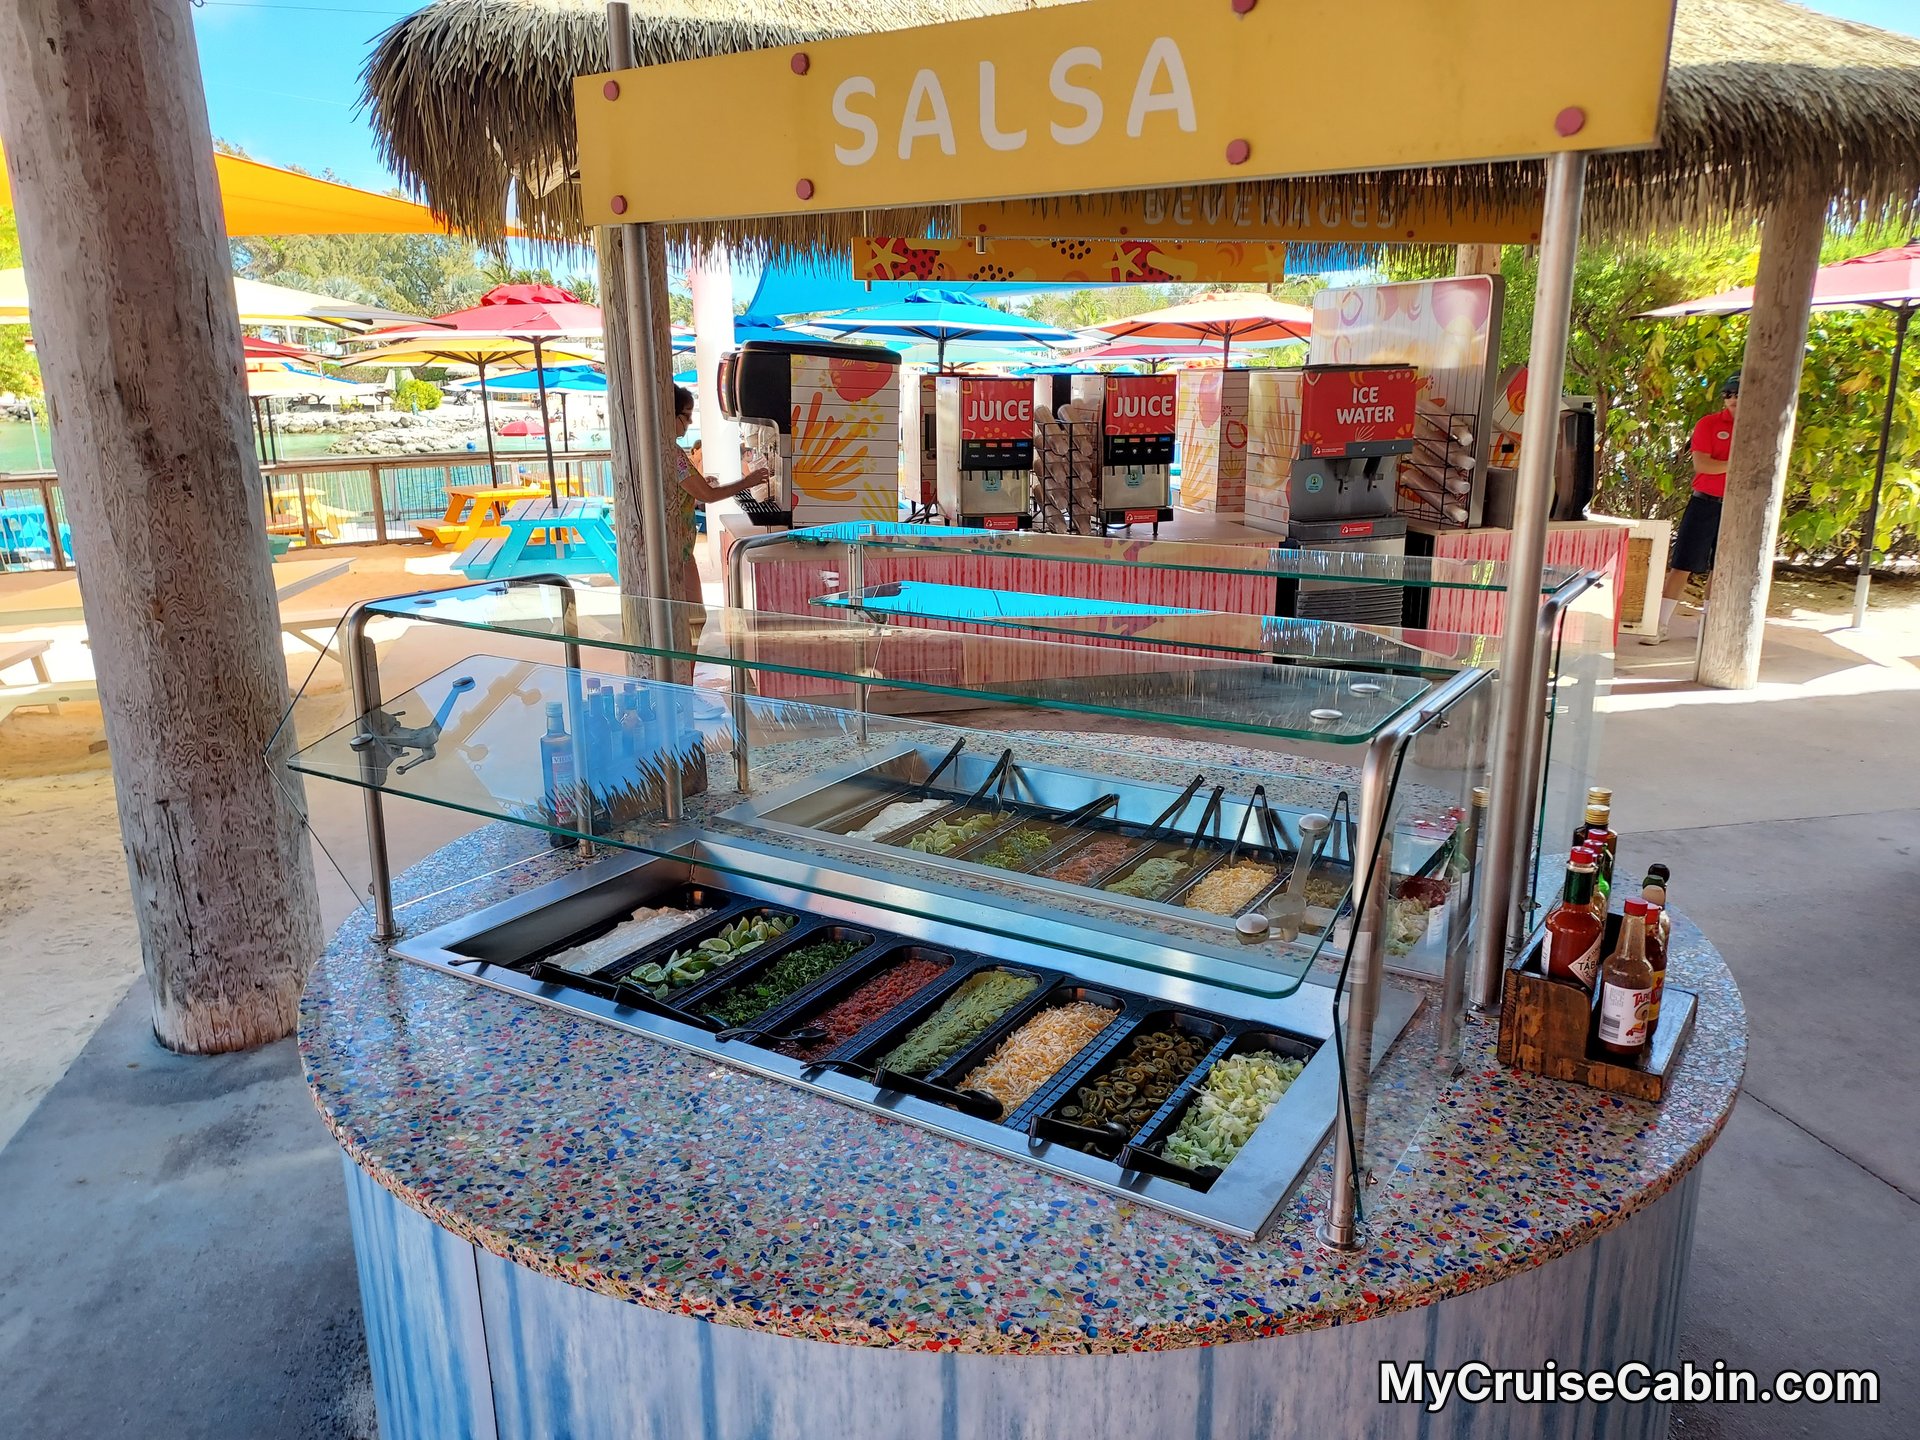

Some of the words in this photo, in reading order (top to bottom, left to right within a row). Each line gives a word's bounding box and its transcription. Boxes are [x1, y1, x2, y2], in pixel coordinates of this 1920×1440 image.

[831, 37, 1198, 166] SALSA
[1352, 386, 1379, 404] ICE
[967, 400, 1031, 422] JUICE
[1113, 395, 1174, 418] JUICE
[1336, 405, 1395, 425] WATER
